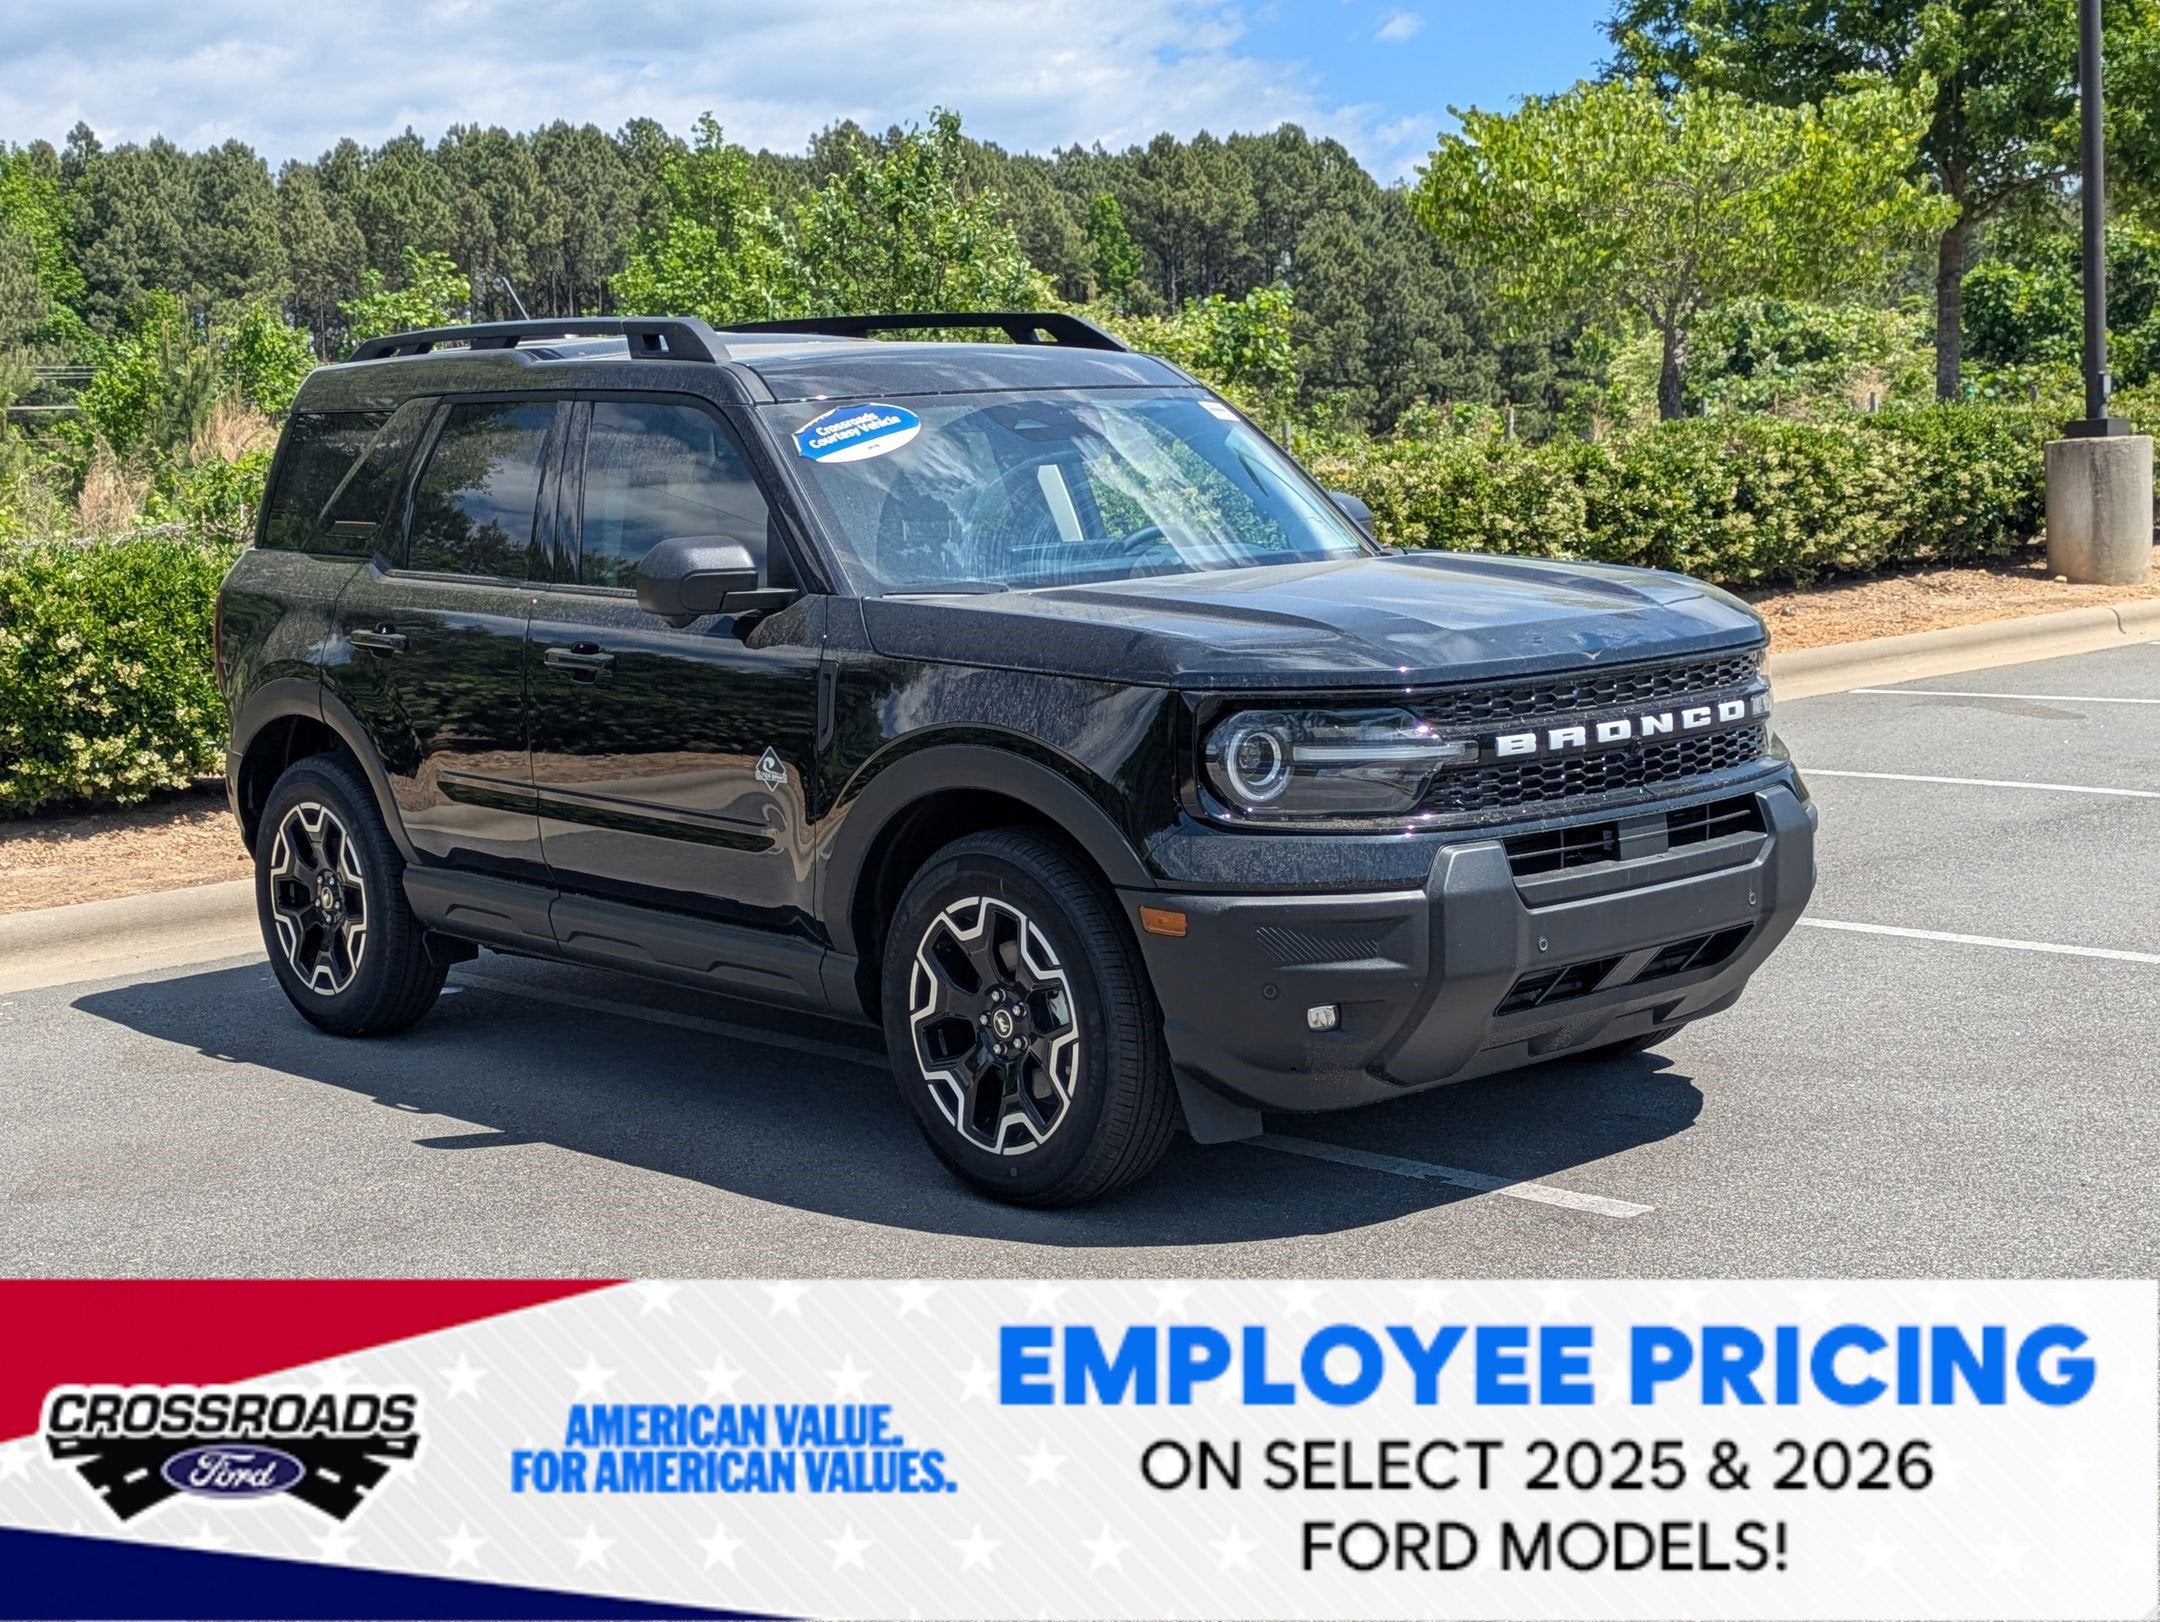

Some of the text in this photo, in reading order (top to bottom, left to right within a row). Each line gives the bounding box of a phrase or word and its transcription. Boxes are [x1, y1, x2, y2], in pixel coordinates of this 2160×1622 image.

[808, 414, 902, 449] Courtesy Vehicle
[815, 411, 880, 437] Crossroads
[1495, 699, 1746, 758] BRONCO
